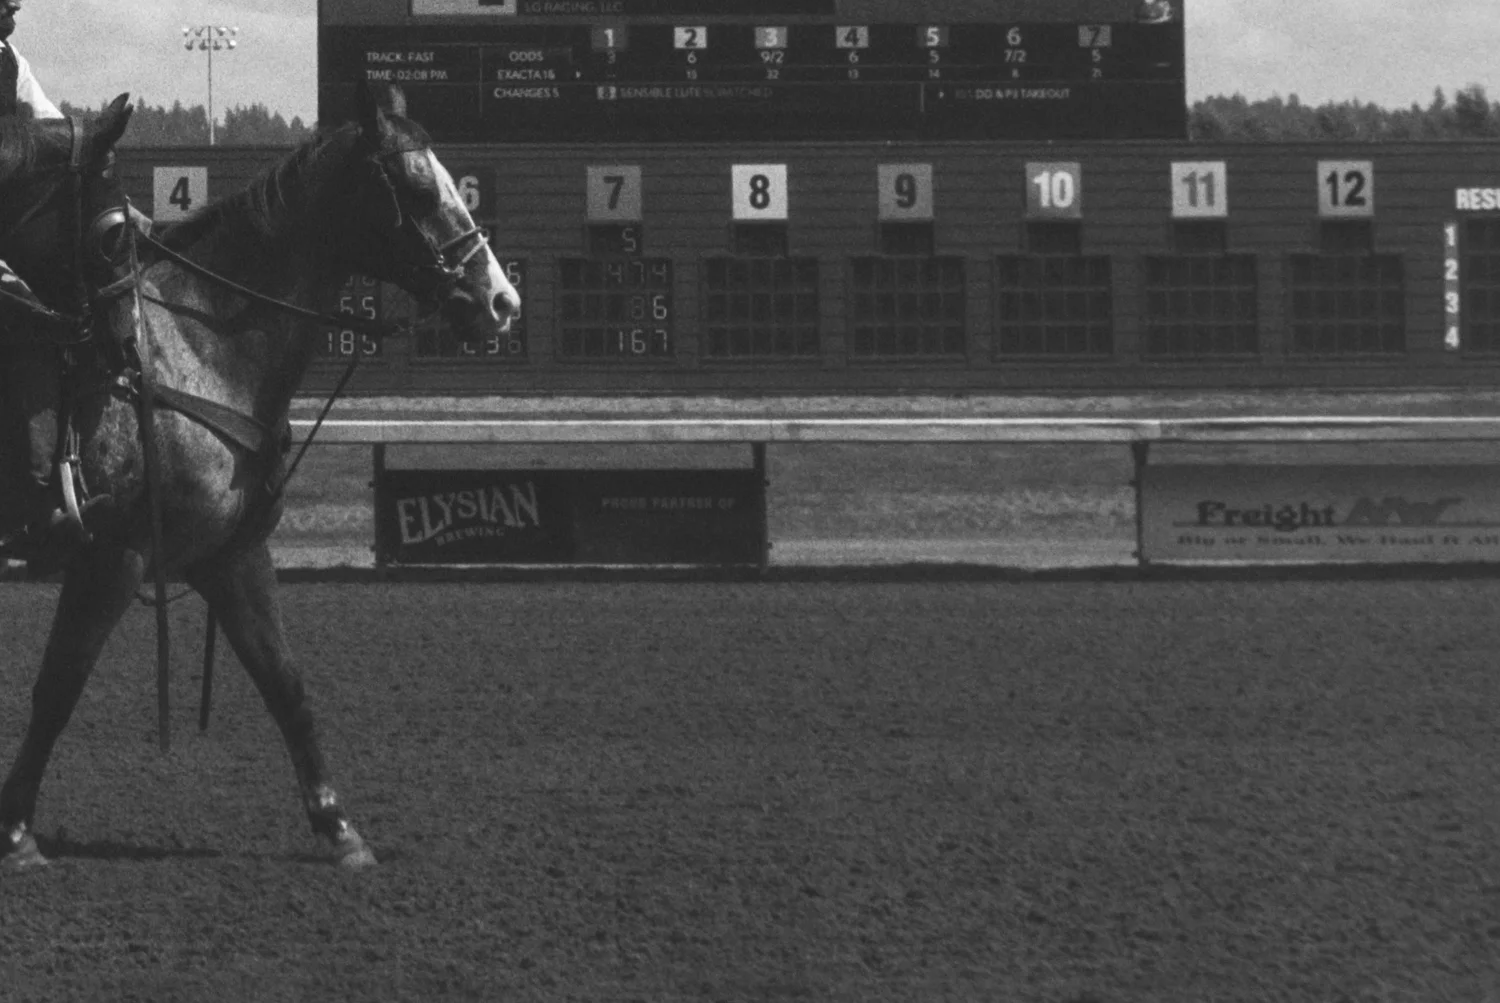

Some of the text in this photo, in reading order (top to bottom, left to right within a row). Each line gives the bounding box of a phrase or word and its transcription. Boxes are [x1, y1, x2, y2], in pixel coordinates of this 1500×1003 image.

[604, 28, 614, 47] 1
[684, 28, 698, 47] 2
[765, 28, 779, 47] 3
[844, 28, 860, 47] 4
[927, 27, 940, 46] 5
[1007, 27, 1022, 46] 6
[408, 51, 434, 62] FAST
[509, 51, 544, 62] ODDS
[687, 51, 697, 64] 6
[760, 52, 784, 64] 9/2
[848, 51, 859, 64] 6
[929, 50, 940, 63] 5
[1004, 49, 1027, 63] 7/2
[498, 70, 542, 81] EXACTA
[169, 176, 191, 211] 4
[458, 175, 480, 211] 6
[603, 175, 624, 210] 7
[749, 174, 770, 209] 8
[894, 173, 916, 209] 9
[1033, 171, 1074, 208] 10
[1181, 171, 1215, 207] 11
[1325, 170, 1366, 207] 12
[622, 227, 636, 252] 5
[1445, 226, 1456, 246] 1
[1444, 259, 1459, 280] 2
[1445, 291, 1460, 313] 3
[619, 329, 668, 354] 167
[1445, 326, 1459, 348] 4
[396, 480, 540, 545] ELYSIAN
[1197, 499, 1335, 532] Freight
[435, 526, 506, 547] BREWING
